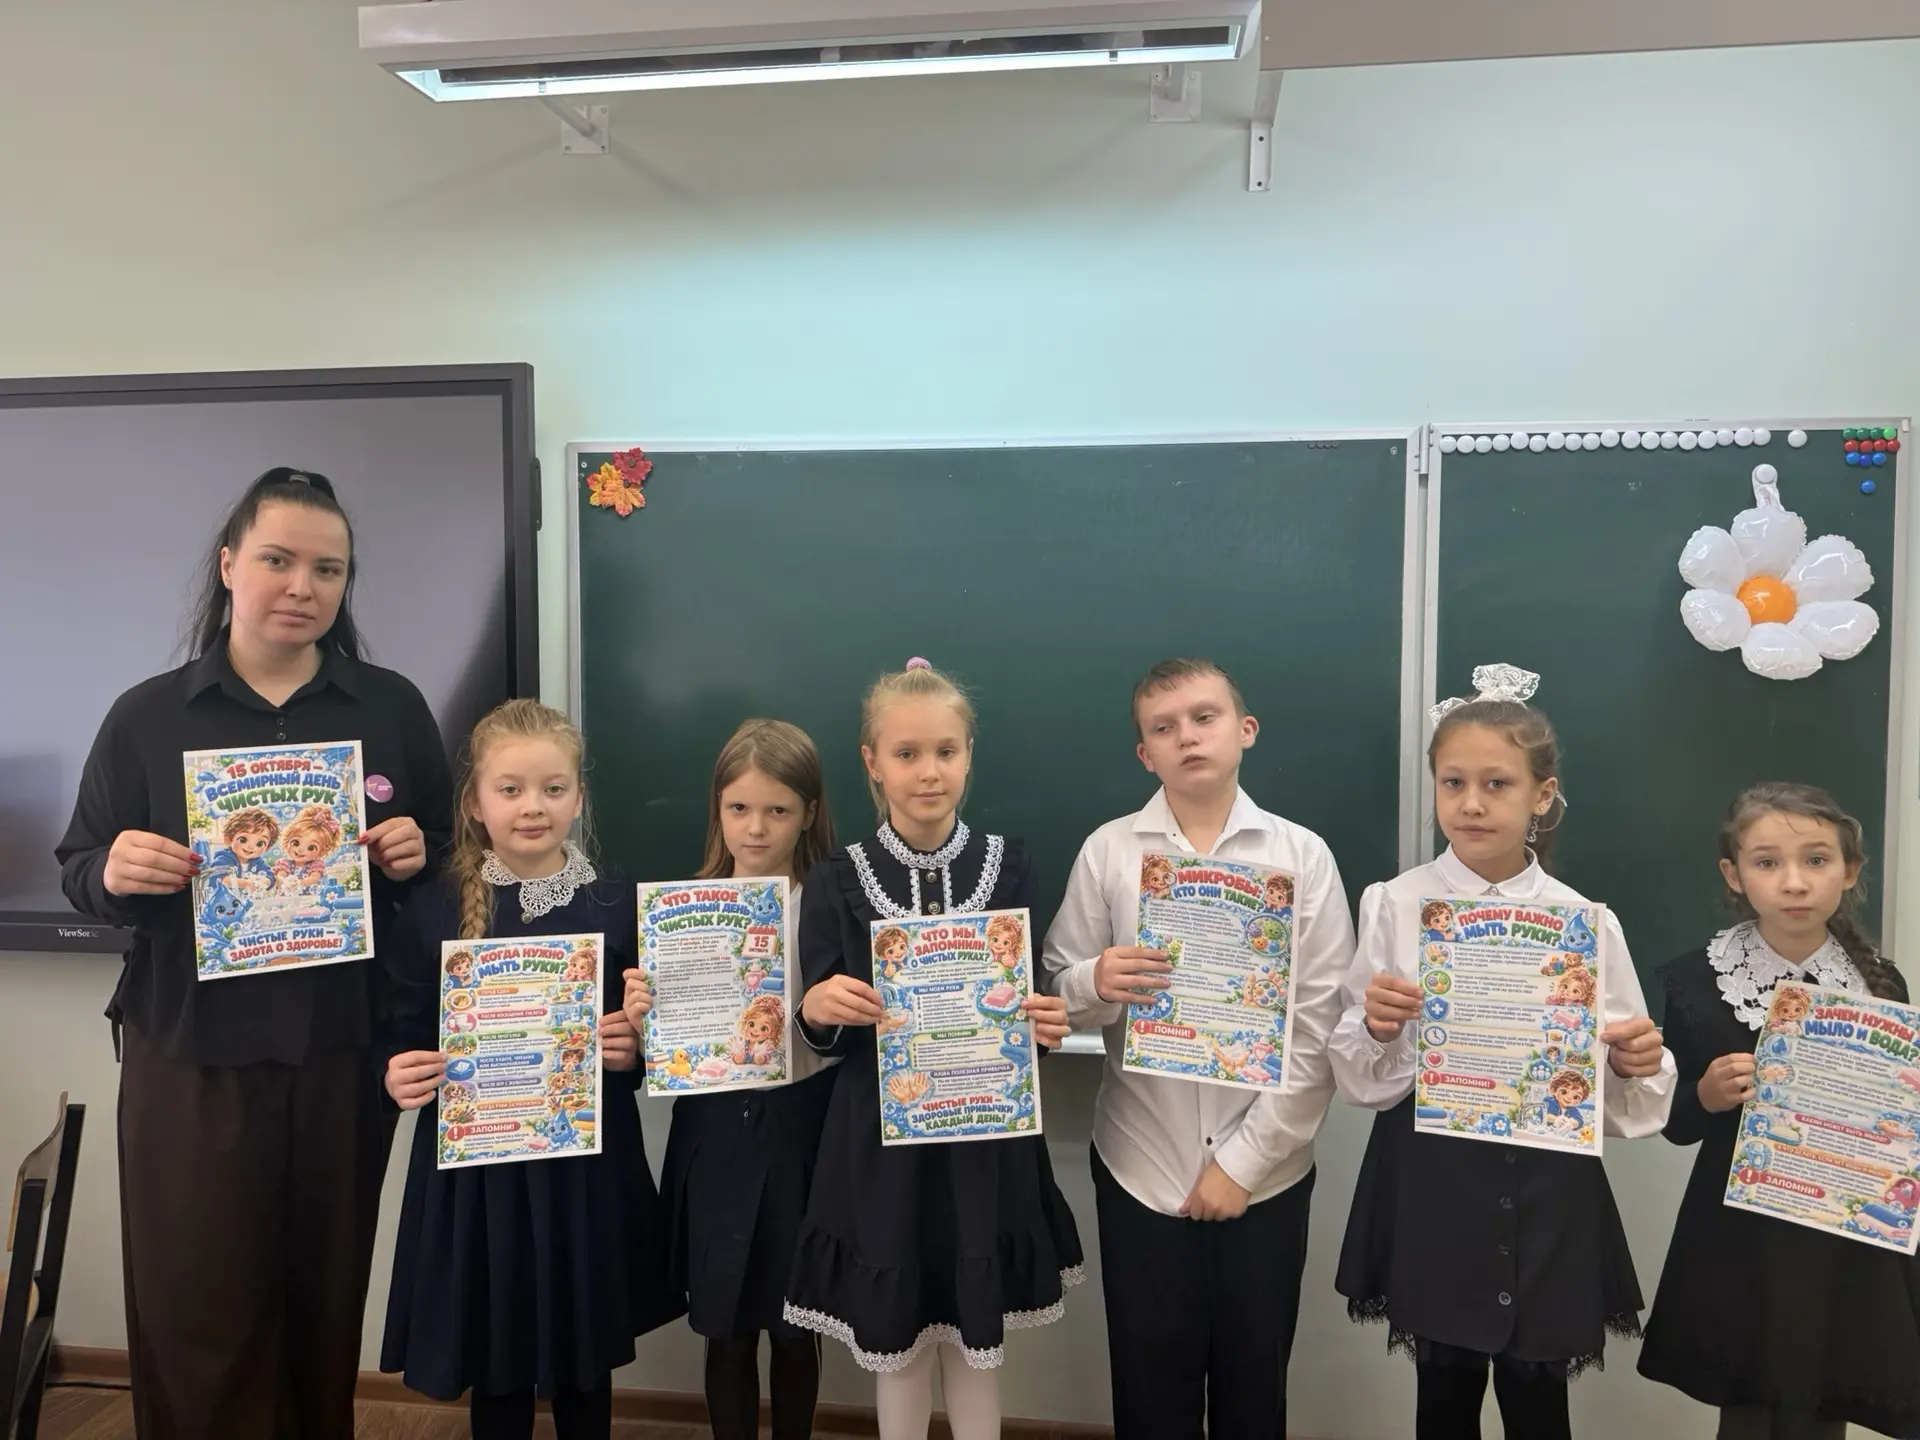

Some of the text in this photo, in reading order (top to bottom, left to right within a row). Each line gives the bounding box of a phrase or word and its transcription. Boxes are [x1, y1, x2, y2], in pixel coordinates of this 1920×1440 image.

[226, 763, 247, 779] 15
[250, 759, 311, 774] ОКТЯБРЯ
[204, 770, 341, 802] ВСЕМИРНЫЙ ДЕНЬ
[216, 787, 337, 812] ЧИСТЫХ РУК
[1176, 869, 1263, 899] МИКРОБЫ:
[662, 889, 739, 907] ЧТО ТАКОЕ
[1173, 885, 1261, 912] КТО ОНИ ТАКИЕ?
[649, 901, 750, 925] ВСЕМИРНЫЙ ДЕНЬ
[657, 913, 752, 933] ЧИСТЫХ РУК?
[1457, 908, 1564, 932] ПОЧЕМУ ВАЖНО
[238, 931, 288, 948] ЧИСТЫЕ
[292, 928, 324, 941] РУКИ
[754, 935, 769, 948] 15
[920, 927, 976, 942] ЧТО МЫ
[1463, 921, 1563, 947] МЫТЬ РУКИ?
[229, 938, 343, 962] ЗАБОТА О ЗДОРОВЬЕ!
[479, 947, 565, 964] КОГДА НУЖНО
[914, 940, 986, 957] ЗАПОМНИЛИ
[477, 959, 569, 979] МЫТЬ РУКИ?
[911, 951, 991, 969] О ЧИСТЫХ РУКАХ?
[1154, 1024, 1192, 1038] ПОМНИ!
[1814, 1006, 1915, 1043] ЗАЧЕМ НУЖНЫ
[1804, 1019, 1854, 1038] МЫЛО
[1856, 1027, 1869, 1041] И
[1868, 1029, 1920, 1062] ВОДА?
[1444, 1075, 1491, 1088] ЗАПОМНИ!
[922, 1097, 967, 1112] ЧИСТЫЕ
[968, 1095, 993, 1105] РУКИ
[911, 1105, 1014, 1123] ЗДОРОВЫЕ ПРИВЫЧКИ
[924, 1112, 1006, 1131] КАЖДЫЙ ДЕНЬ!
[470, 1123, 515, 1134] ЗАПОМНИ!
[1765, 1175, 1819, 1196] ЗАПОМНИ!
